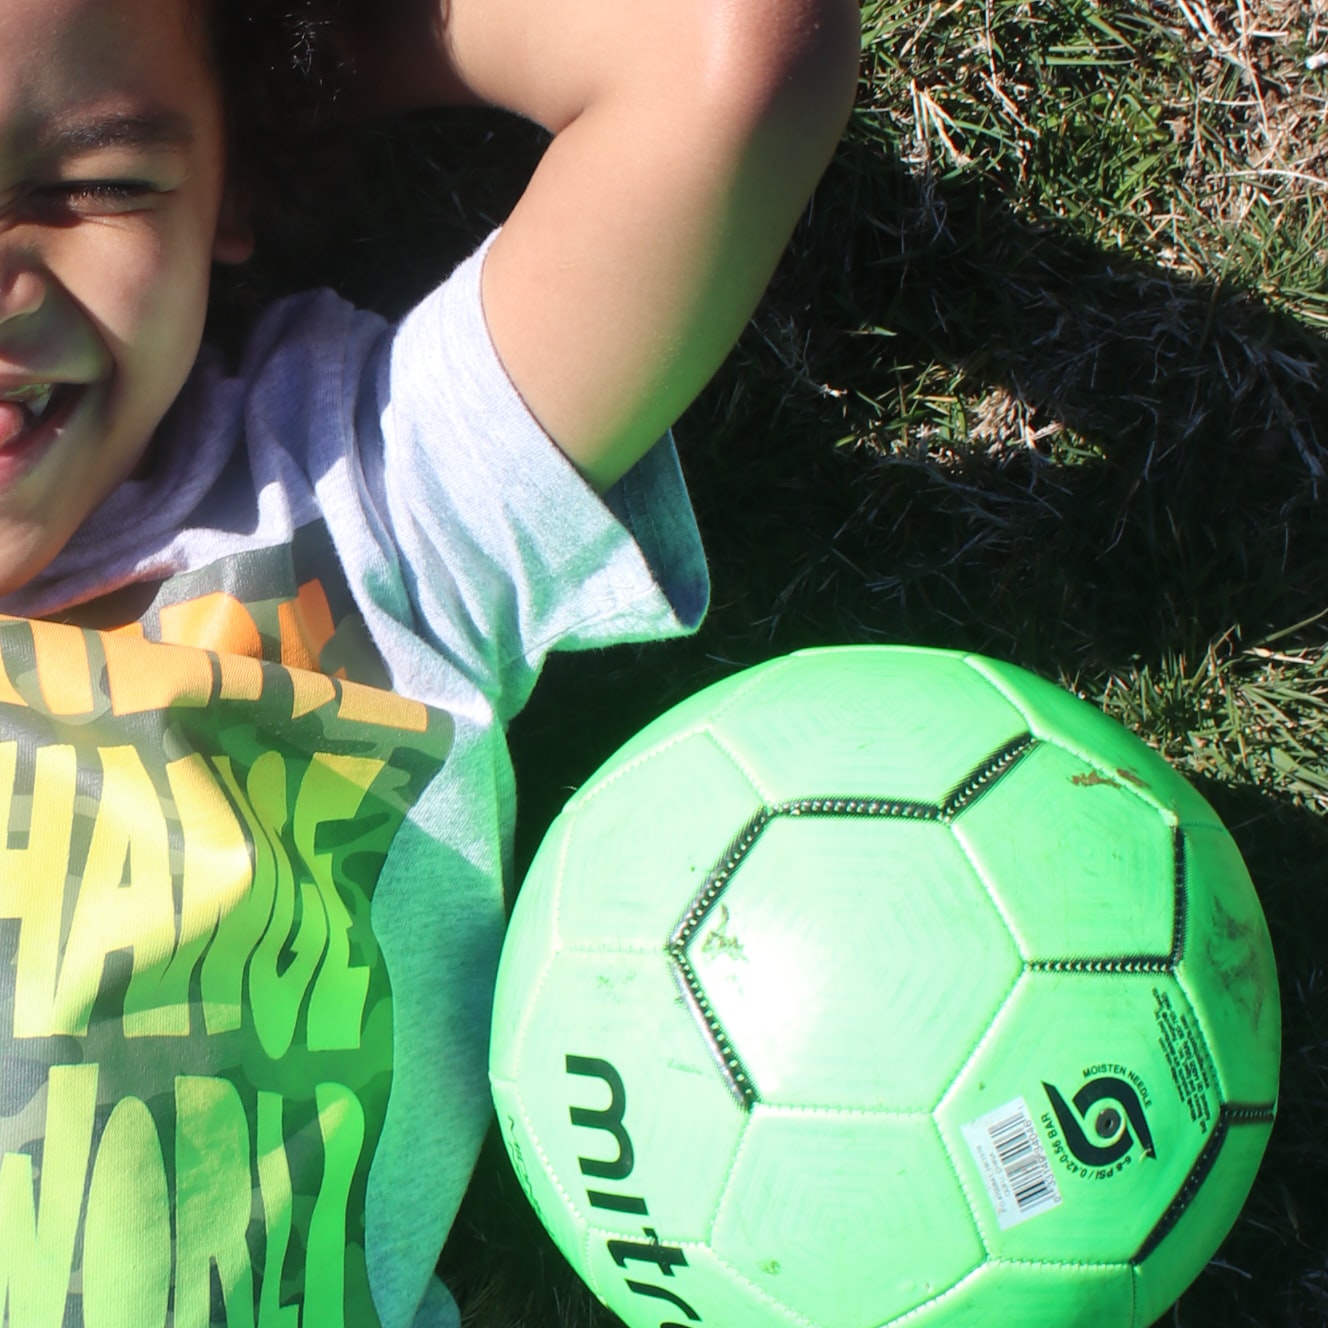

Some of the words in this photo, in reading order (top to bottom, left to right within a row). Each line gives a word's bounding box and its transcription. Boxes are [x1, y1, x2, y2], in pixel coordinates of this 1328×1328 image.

[1082, 1063, 1127, 1078] MOISTEN
[1127, 1070, 1152, 1109] NEEDLE
[1040, 1112, 1058, 1139] BAR
[1095, 1170, 1114, 1180] PSI
